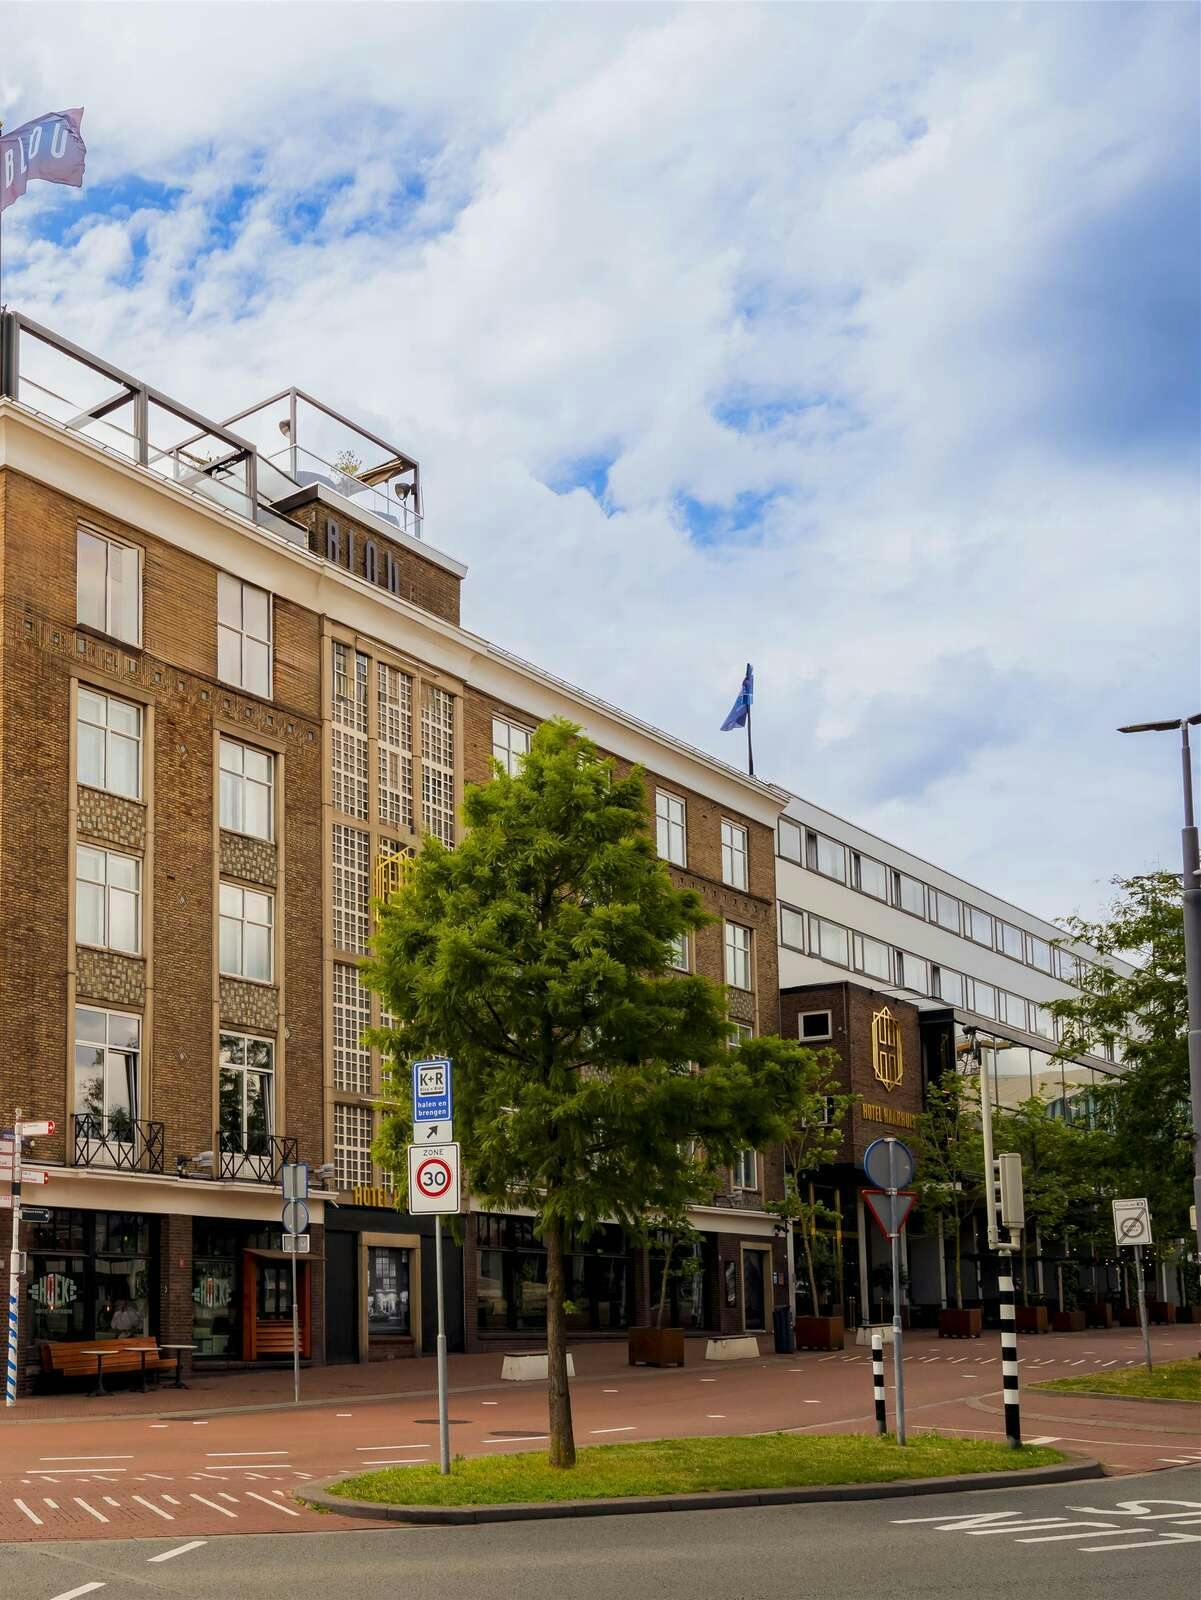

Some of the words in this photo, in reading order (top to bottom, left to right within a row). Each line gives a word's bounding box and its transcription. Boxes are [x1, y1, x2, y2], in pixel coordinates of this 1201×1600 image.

[420, 1072, 443, 1086] K+R
[418, 1109, 447, 1117] brengen
[863, 1103, 883, 1122] HOTEL
[423, 1171, 446, 1187] 30
